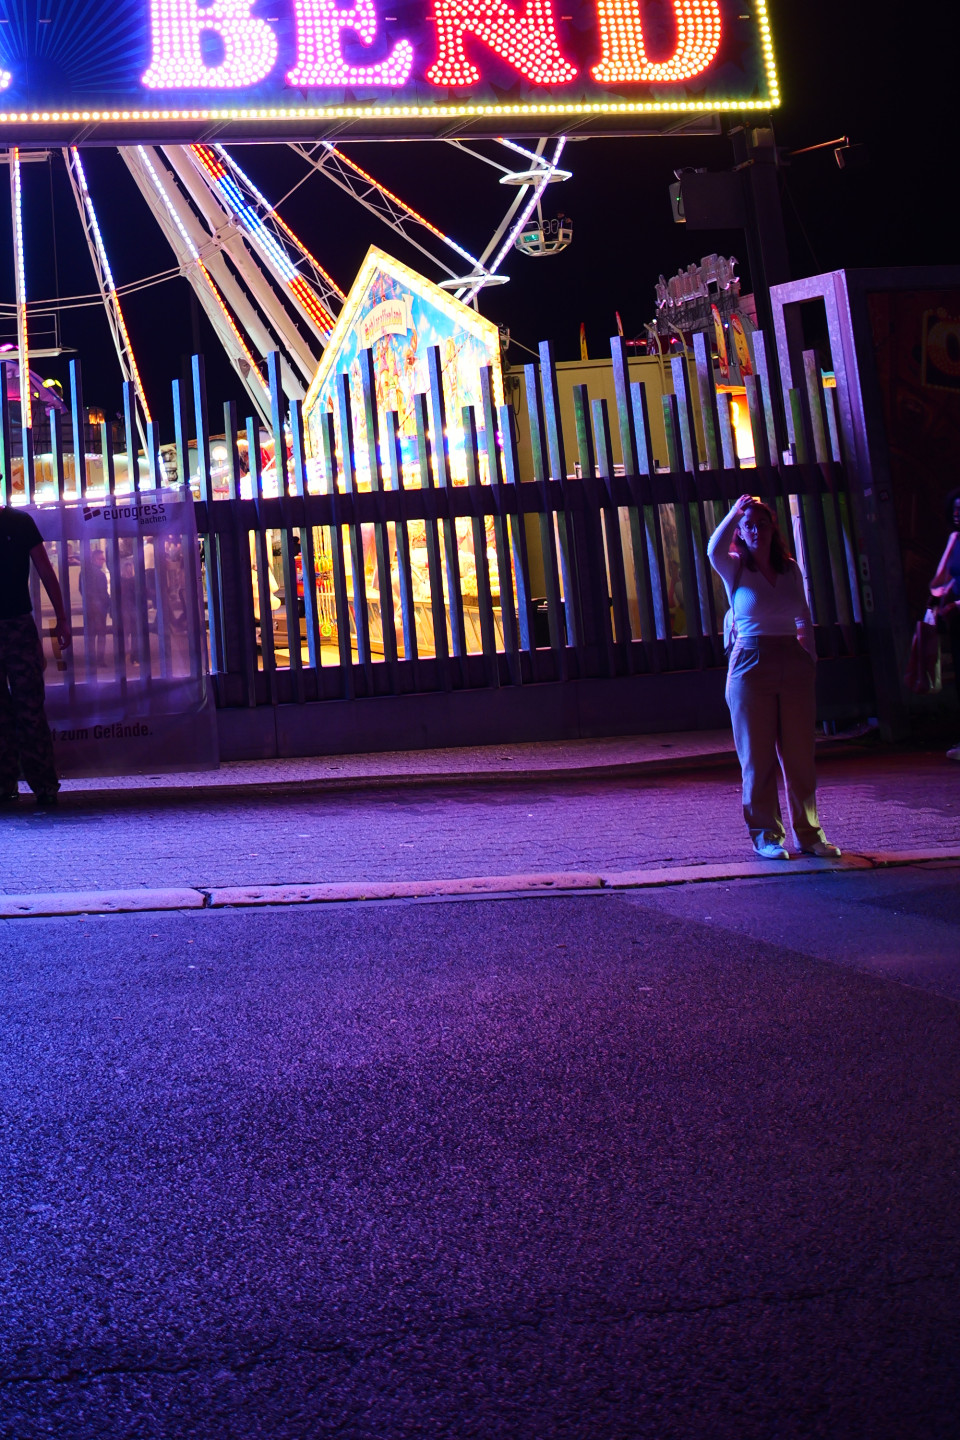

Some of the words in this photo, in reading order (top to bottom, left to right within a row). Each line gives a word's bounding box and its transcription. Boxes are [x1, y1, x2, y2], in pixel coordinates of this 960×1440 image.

[103, 503, 166, 521] eurogress
[140, 514, 167, 525] aachen
[60, 728, 89, 741] zum
[93, 723, 153, 740] Gelände.
